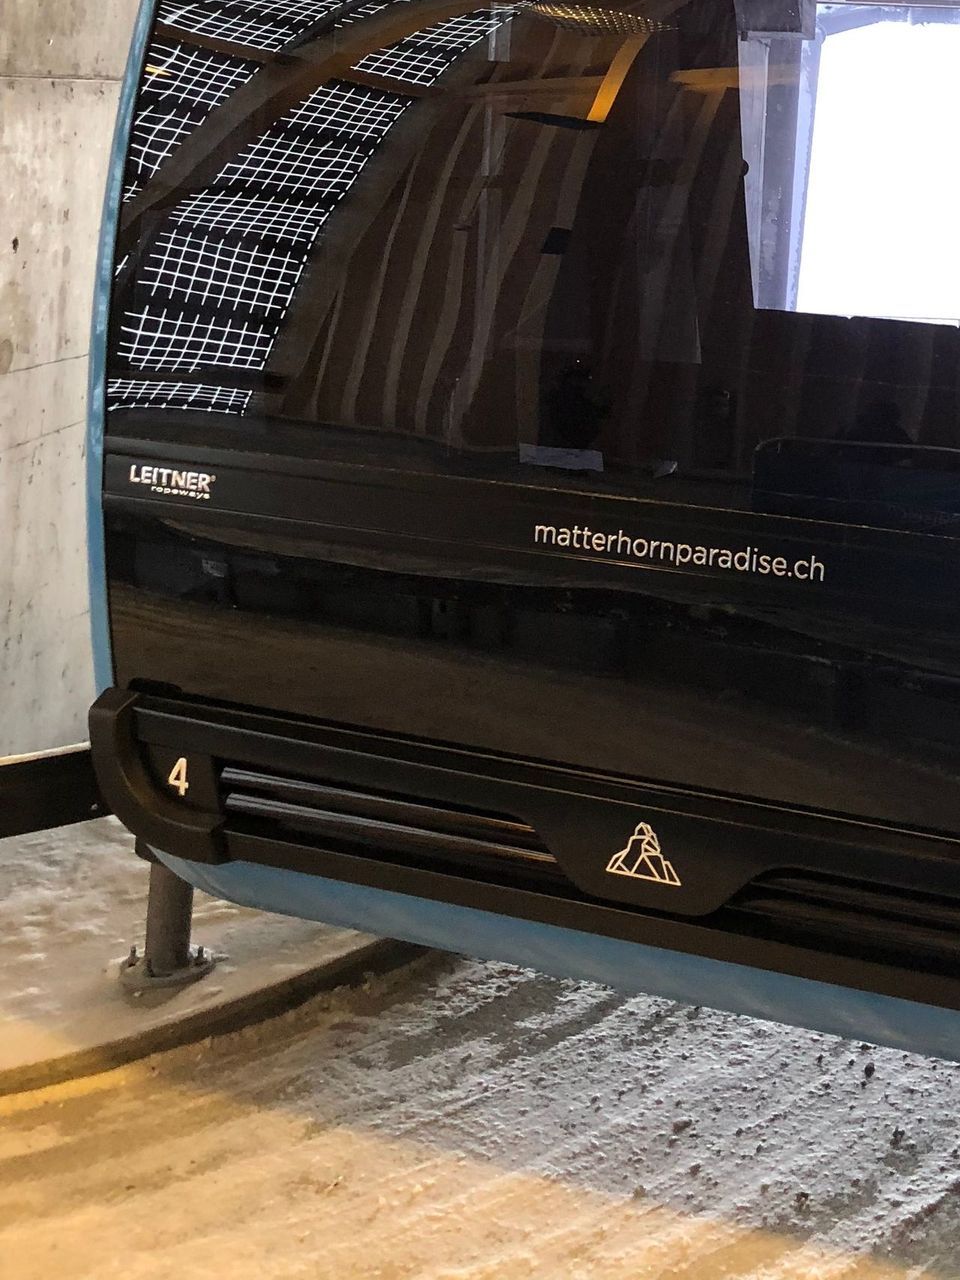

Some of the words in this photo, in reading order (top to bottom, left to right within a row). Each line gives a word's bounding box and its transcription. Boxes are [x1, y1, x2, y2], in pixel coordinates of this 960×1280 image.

[150, 485, 211, 500] ropeways
[534, 525, 825, 582] matterhornparadise.ch
[167, 757, 189, 796] 4
